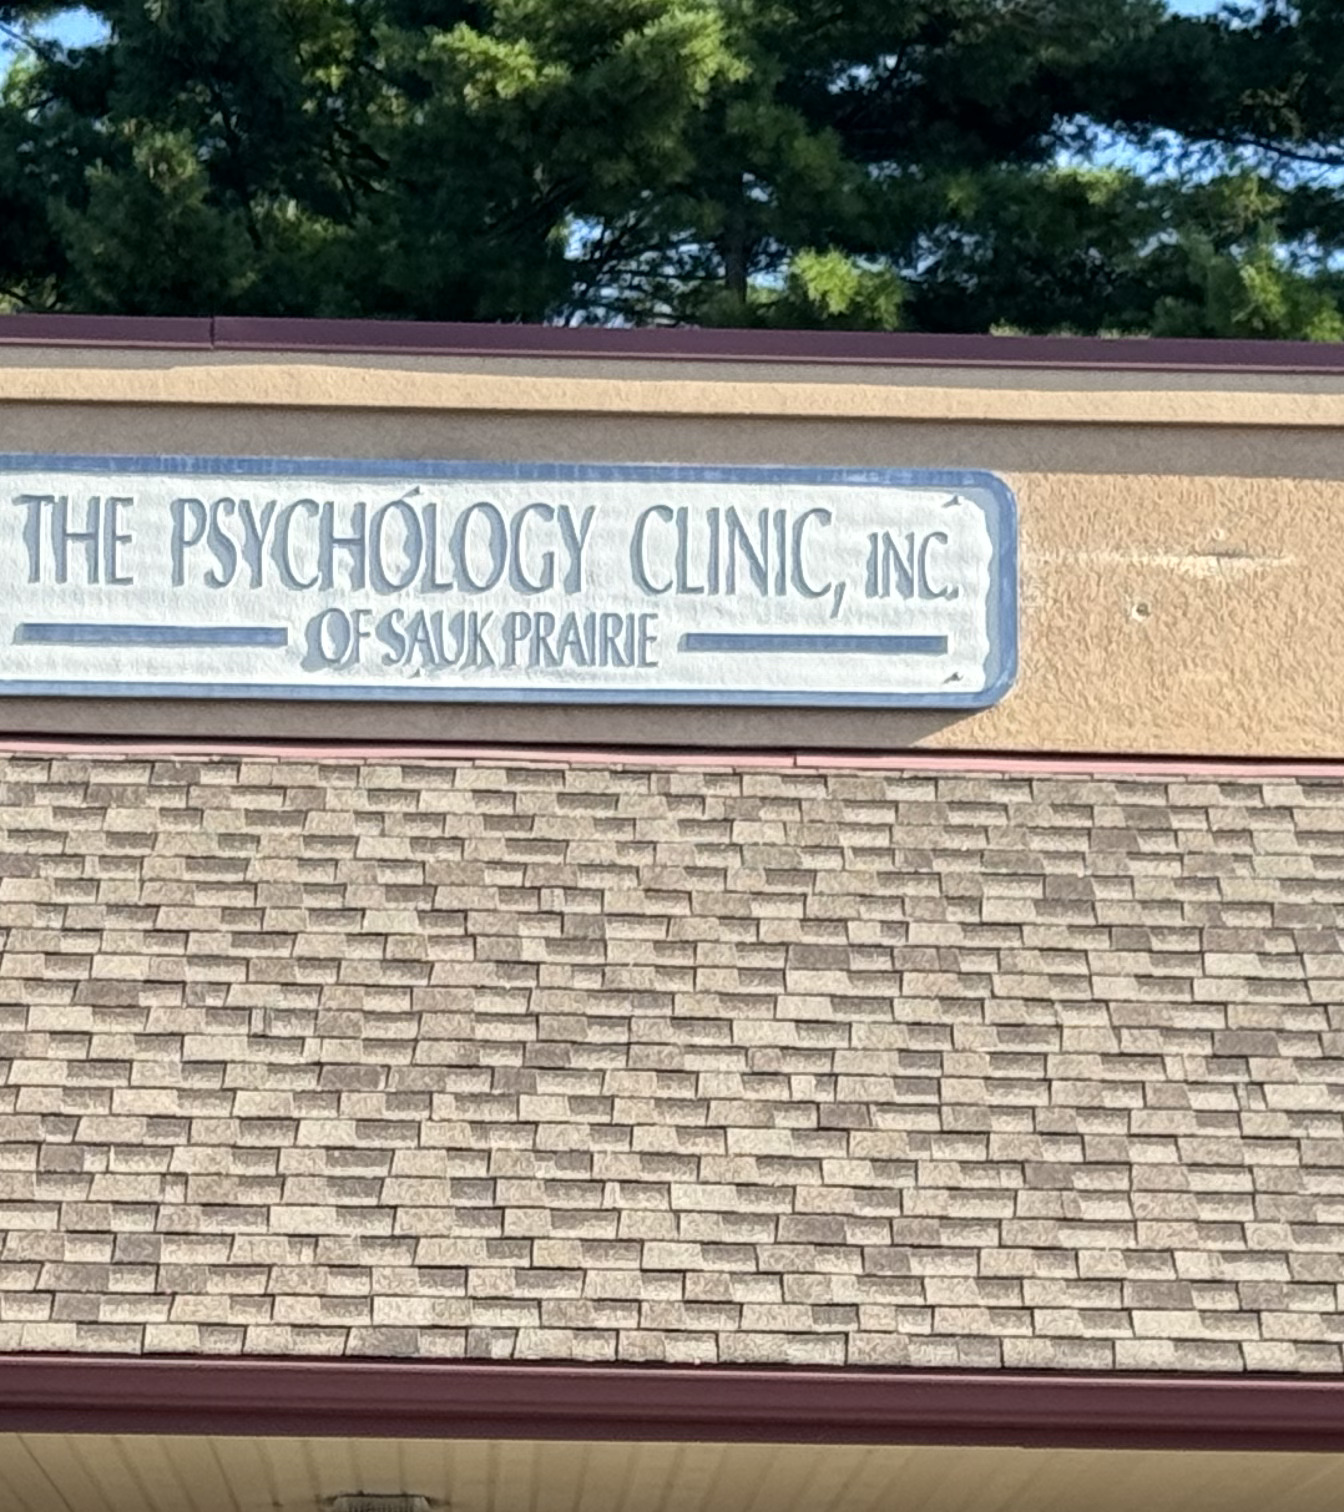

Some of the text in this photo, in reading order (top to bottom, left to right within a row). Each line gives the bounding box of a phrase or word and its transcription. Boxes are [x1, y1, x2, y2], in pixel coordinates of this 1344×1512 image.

[12, 494, 959, 618] THE PSYCHOLOGY CLINIC, INC.
[301, 607, 659, 672] OF SAUK PRAIRIE
